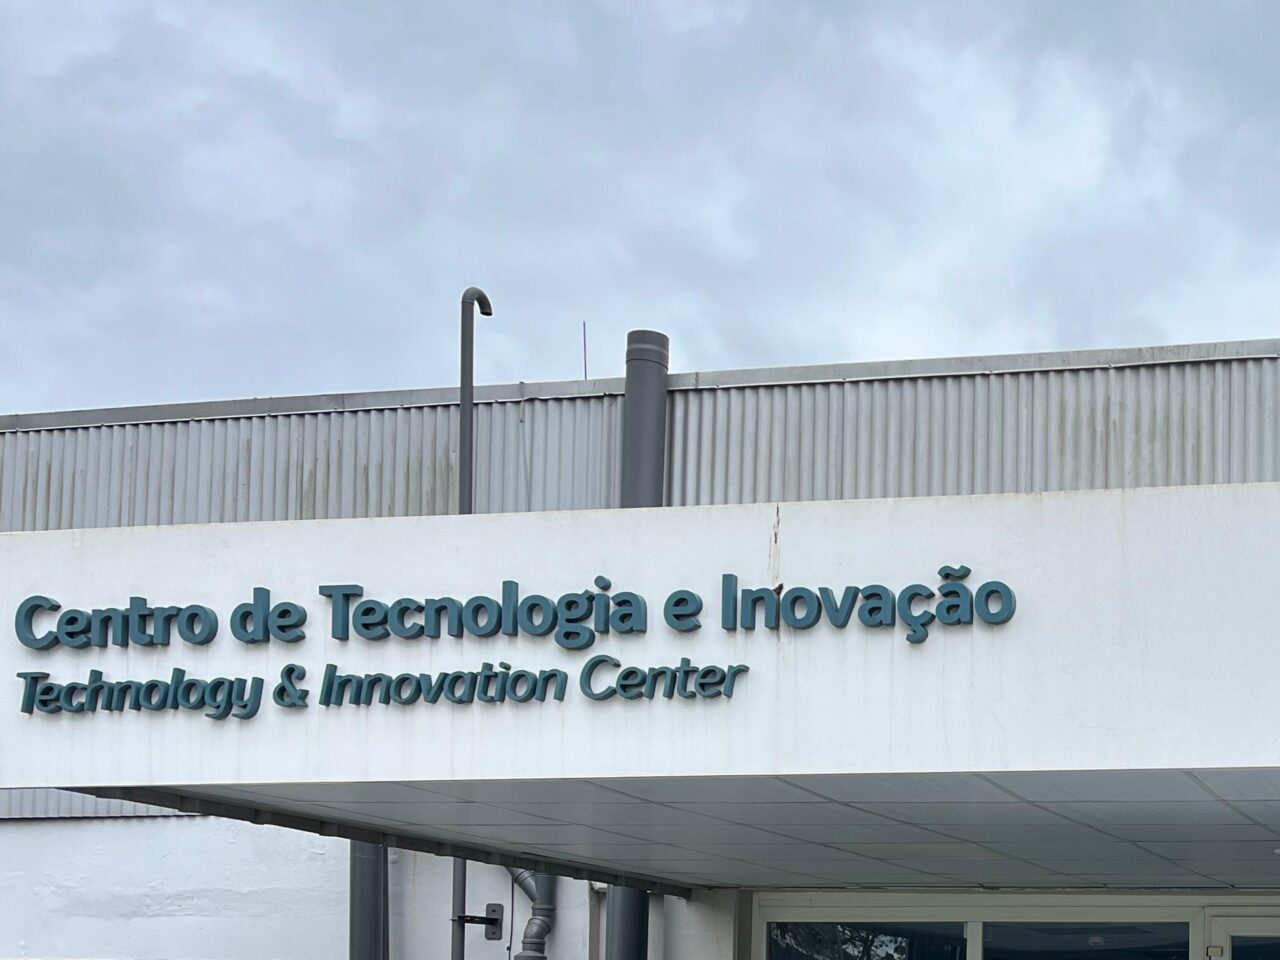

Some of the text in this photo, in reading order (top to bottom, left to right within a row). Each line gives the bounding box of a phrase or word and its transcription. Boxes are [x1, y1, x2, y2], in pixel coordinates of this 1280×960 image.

[15, 564, 1017, 650] Centro de Tecnologia e Inovação
[16, 654, 750, 720] Technology & Innovation Center
